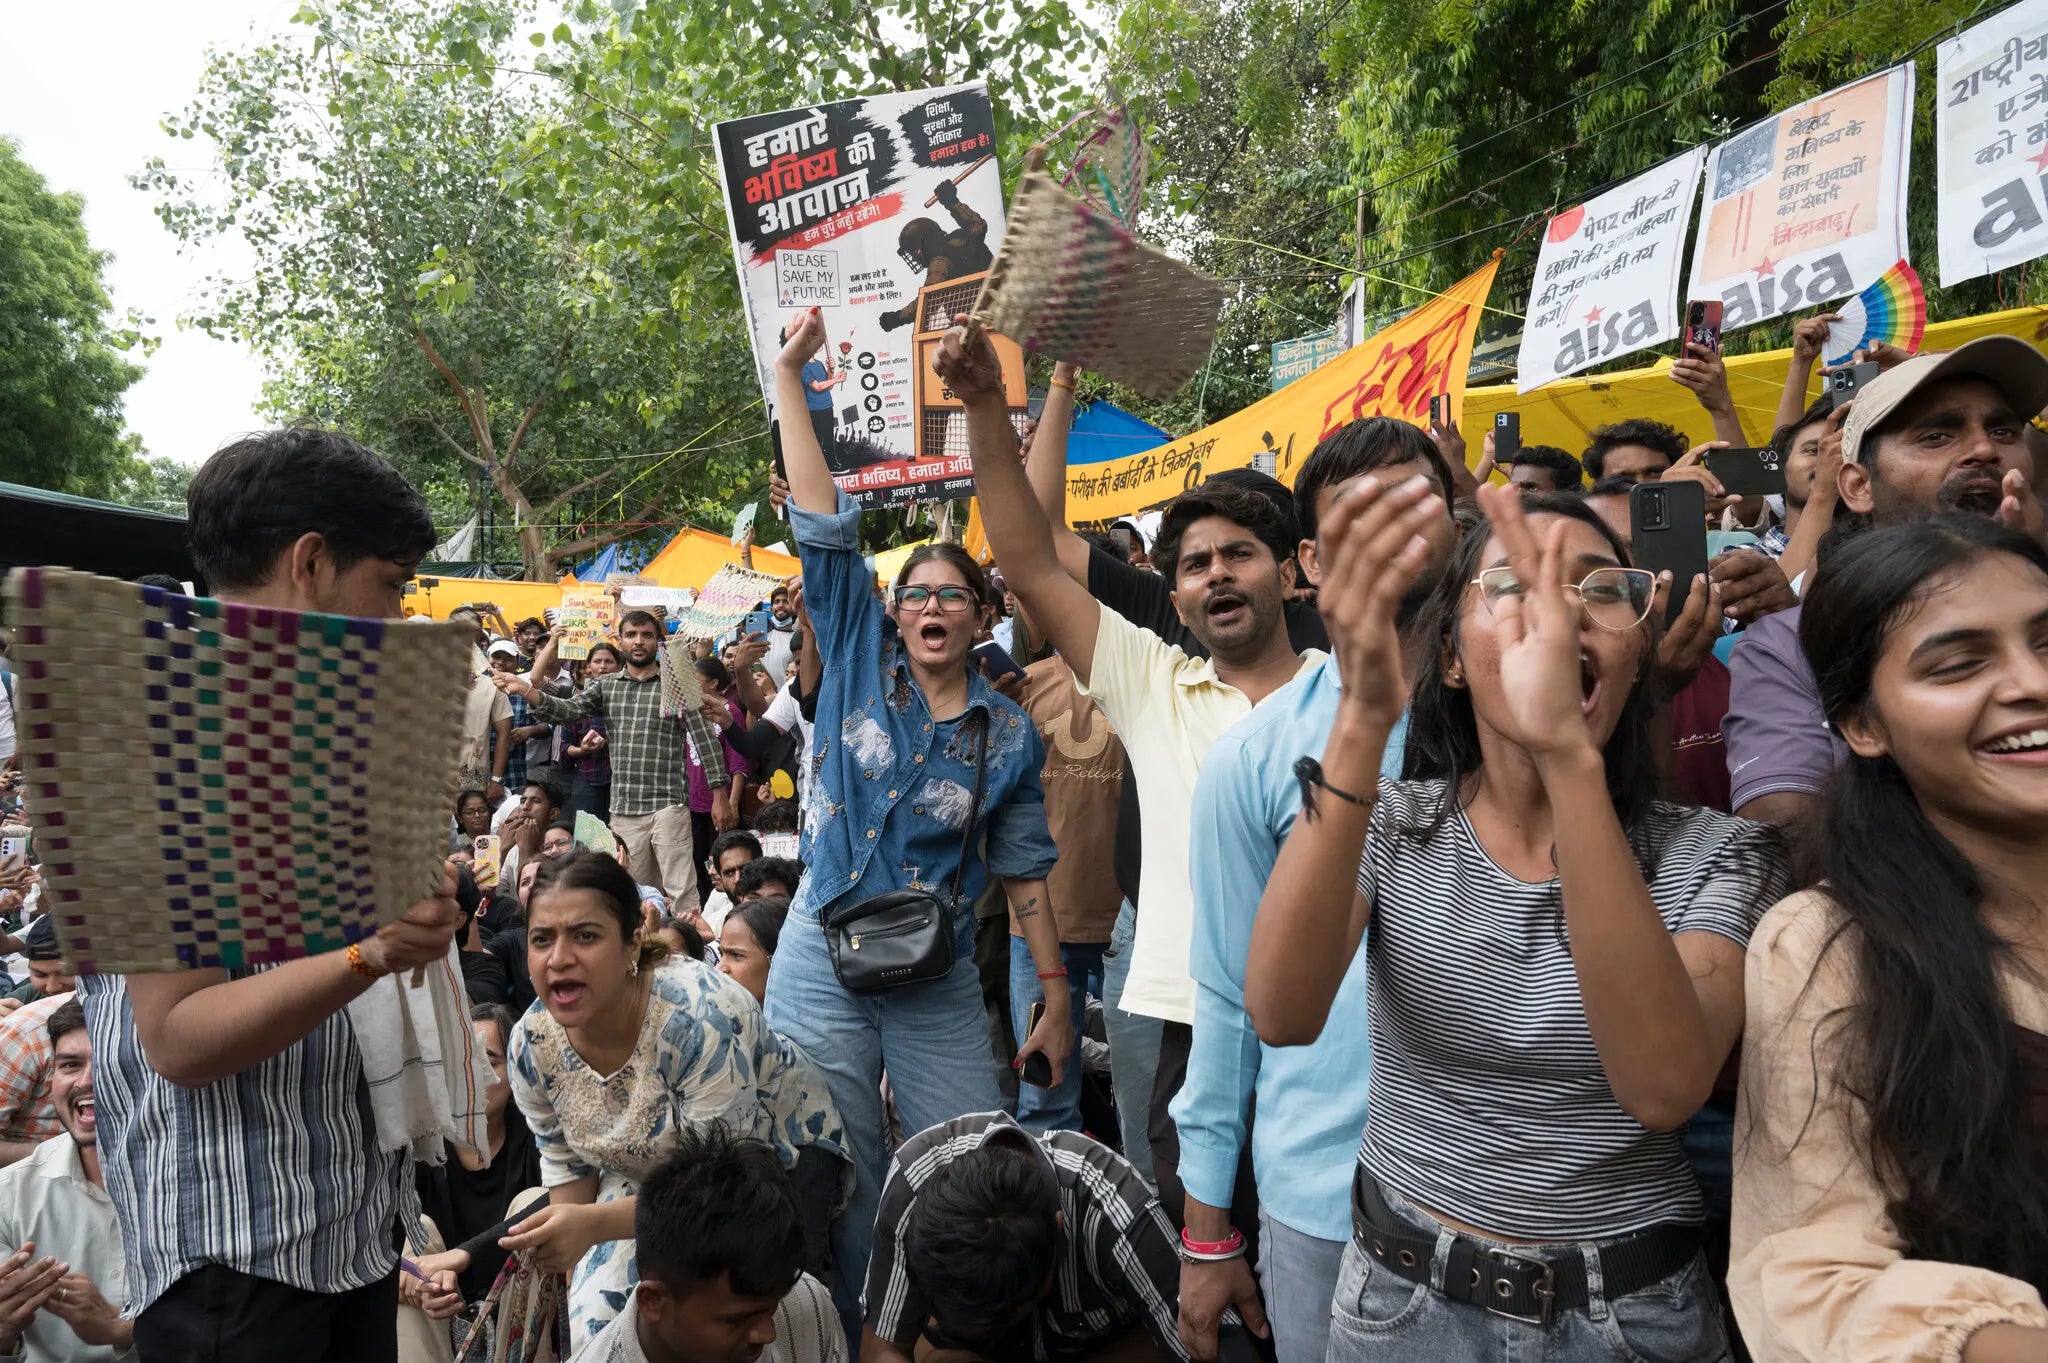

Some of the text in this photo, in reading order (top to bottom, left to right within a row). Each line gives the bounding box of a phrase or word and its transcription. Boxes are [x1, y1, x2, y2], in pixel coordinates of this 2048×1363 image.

[925, 101, 954, 118] शिक्षा,
[922, 112, 963, 136] सुरक्षा और
[1845, 120, 1865, 137] के
[744, 107, 828, 168] हमारे
[928, 128, 963, 147] अधिकार
[929, 132, 991, 162] हमारा हक है!
[1975, 130, 2018, 165] को
[744, 131, 875, 204] भविष्य की
[1781, 162, 1812, 181] लिए
[758, 167, 870, 234] आवाज़
[1583, 211, 1619, 241] पेपर
[1661, 178, 1680, 201] से
[1777, 201, 1799, 216] का
[803, 227, 820, 242] हम
[782, 252, 828, 268] PLEASE
[1581, 243, 1604, 264] की
[782, 270, 834, 283] SAVE MY
[1537, 283, 1560, 307] की
[1631, 241, 1660, 265] तय
[793, 286, 835, 299] FUTURE
[1721, 252, 1854, 331] aisa
[1554, 299, 1659, 374] aisa
[1275, 357, 1313, 380] जनता
[832, 455, 973, 489] मारा भविष्य, हमारा अधि
[1097, 468, 1113, 496] की
[1144, 456, 1159, 482] के
[917, 483, 927, 494] दो
[944, 478, 971, 490] सम्मान
[561, 618, 588, 628] VIKAS
